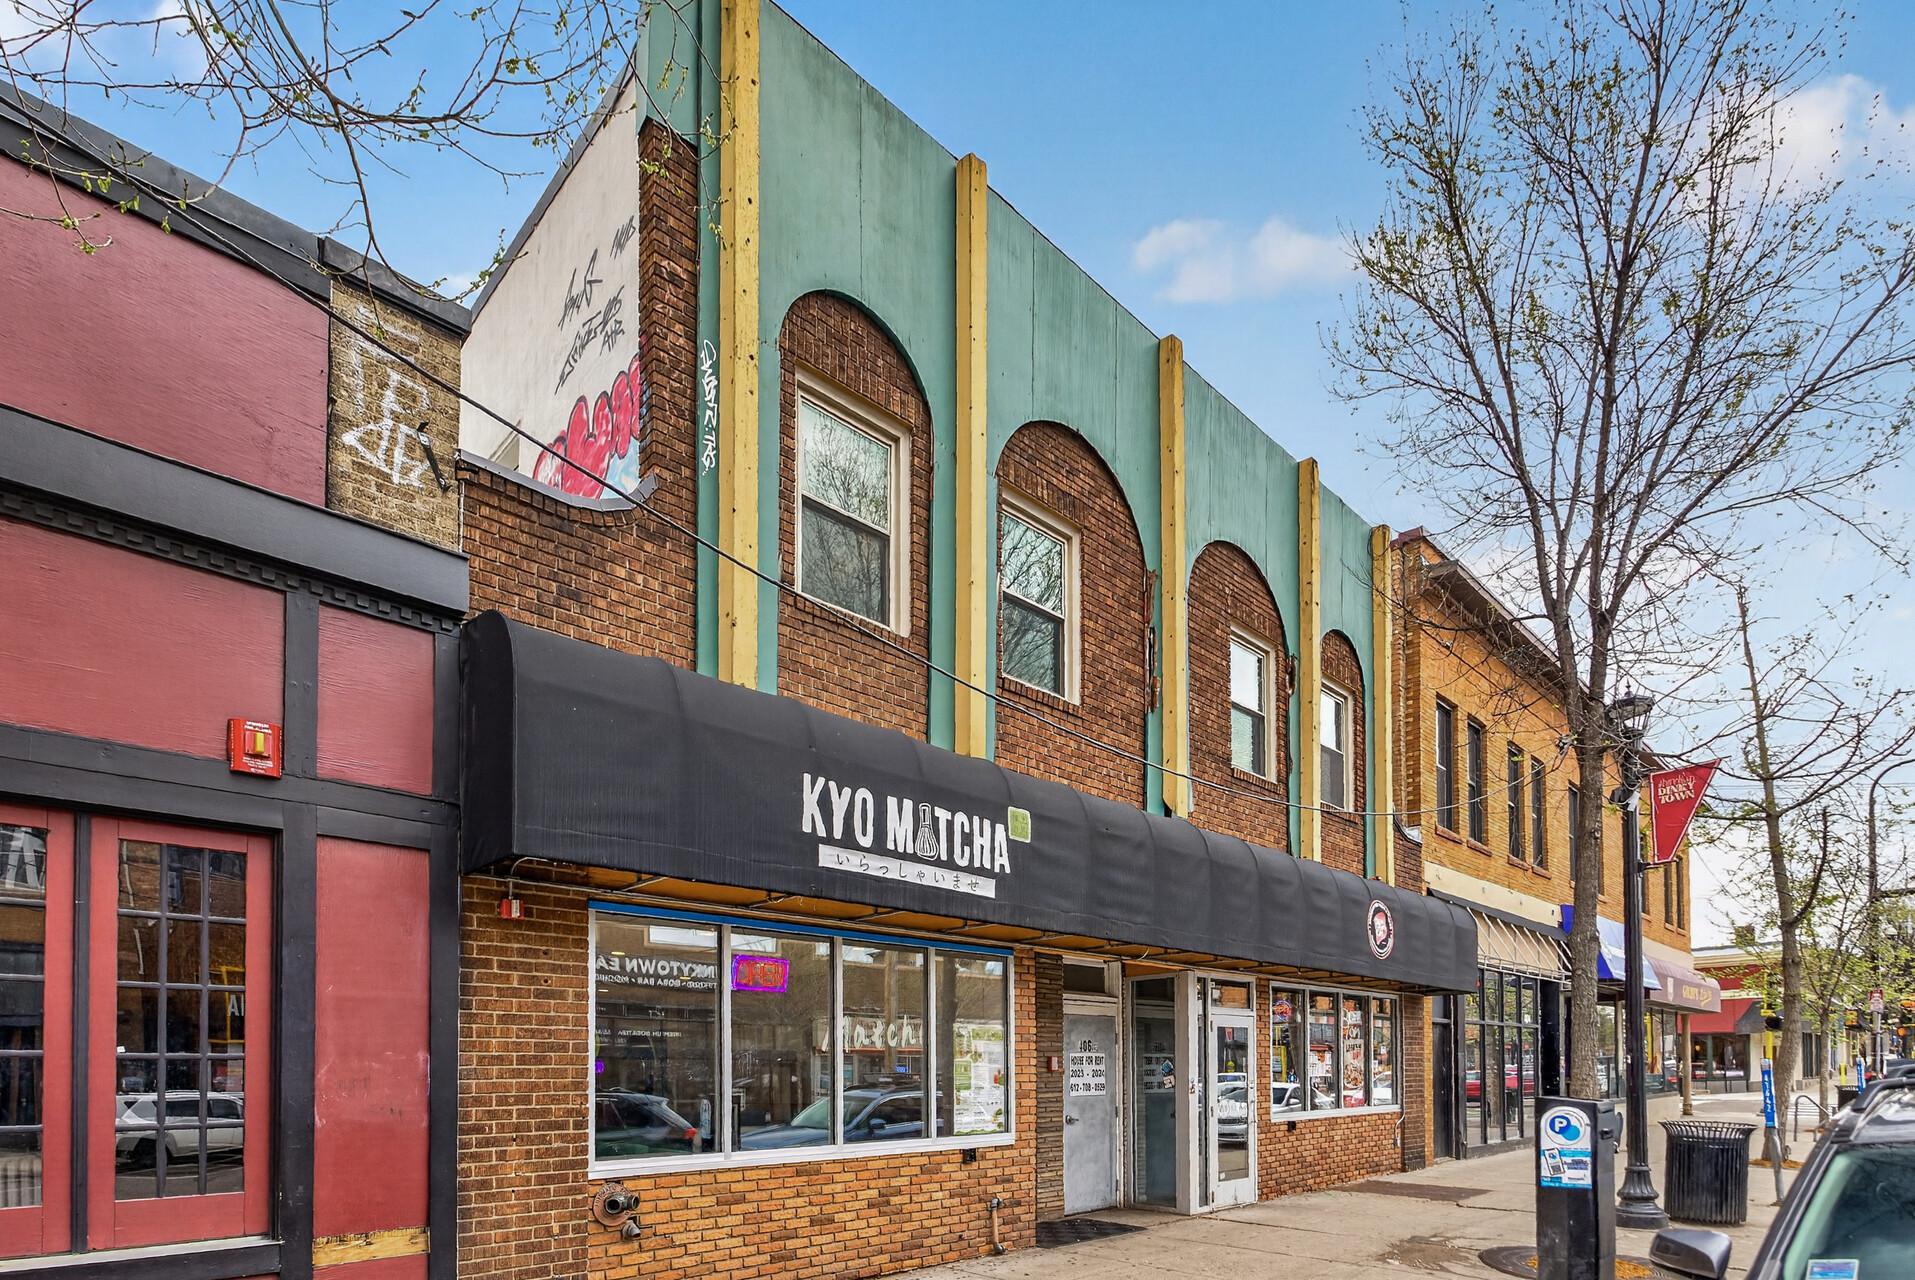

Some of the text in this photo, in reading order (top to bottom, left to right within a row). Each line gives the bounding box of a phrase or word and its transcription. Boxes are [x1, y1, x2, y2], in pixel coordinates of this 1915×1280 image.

[1658, 782, 1694, 796] DINKY
[1659, 790, 1695, 804] TOWN
[802, 772, 874, 848] KYO
[835, 852, 980, 892] いらっしゃいませ
[1071, 1055, 1105, 1067] HOUSE FOR RENT
[1070, 1068, 1085, 1078] 2023
